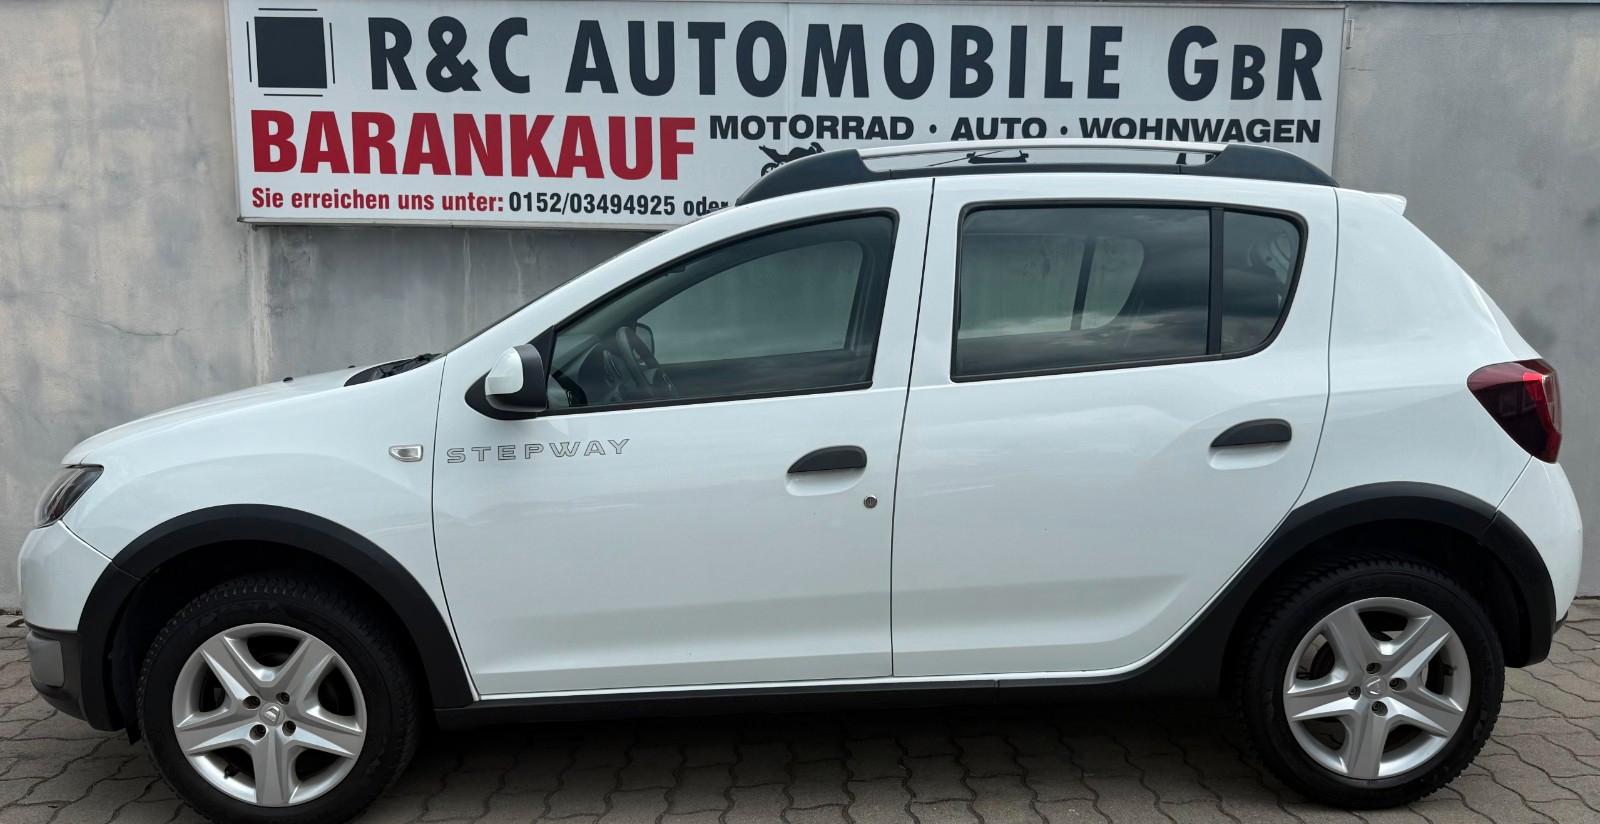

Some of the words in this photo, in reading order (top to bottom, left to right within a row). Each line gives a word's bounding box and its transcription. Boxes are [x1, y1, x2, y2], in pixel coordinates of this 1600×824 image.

[367, 16, 530, 93] R&C
[565, 20, 1123, 100] AUTOMOBILE
[709, 114, 914, 140] MOTORRAD
[951, 116, 1047, 139] AUTO
[1079, 117, 1321, 143] WOHNWAGEN
[251, 110, 695, 180] BARANKAUF
[252, 187, 284, 208] Sie
[291, 189, 390, 210] erreichen
[398, 193, 435, 211] uns
[442, 192, 503, 212] unter:
[509, 191, 676, 216] 0152/03494925
[447, 438, 630, 463] STEPWAY
